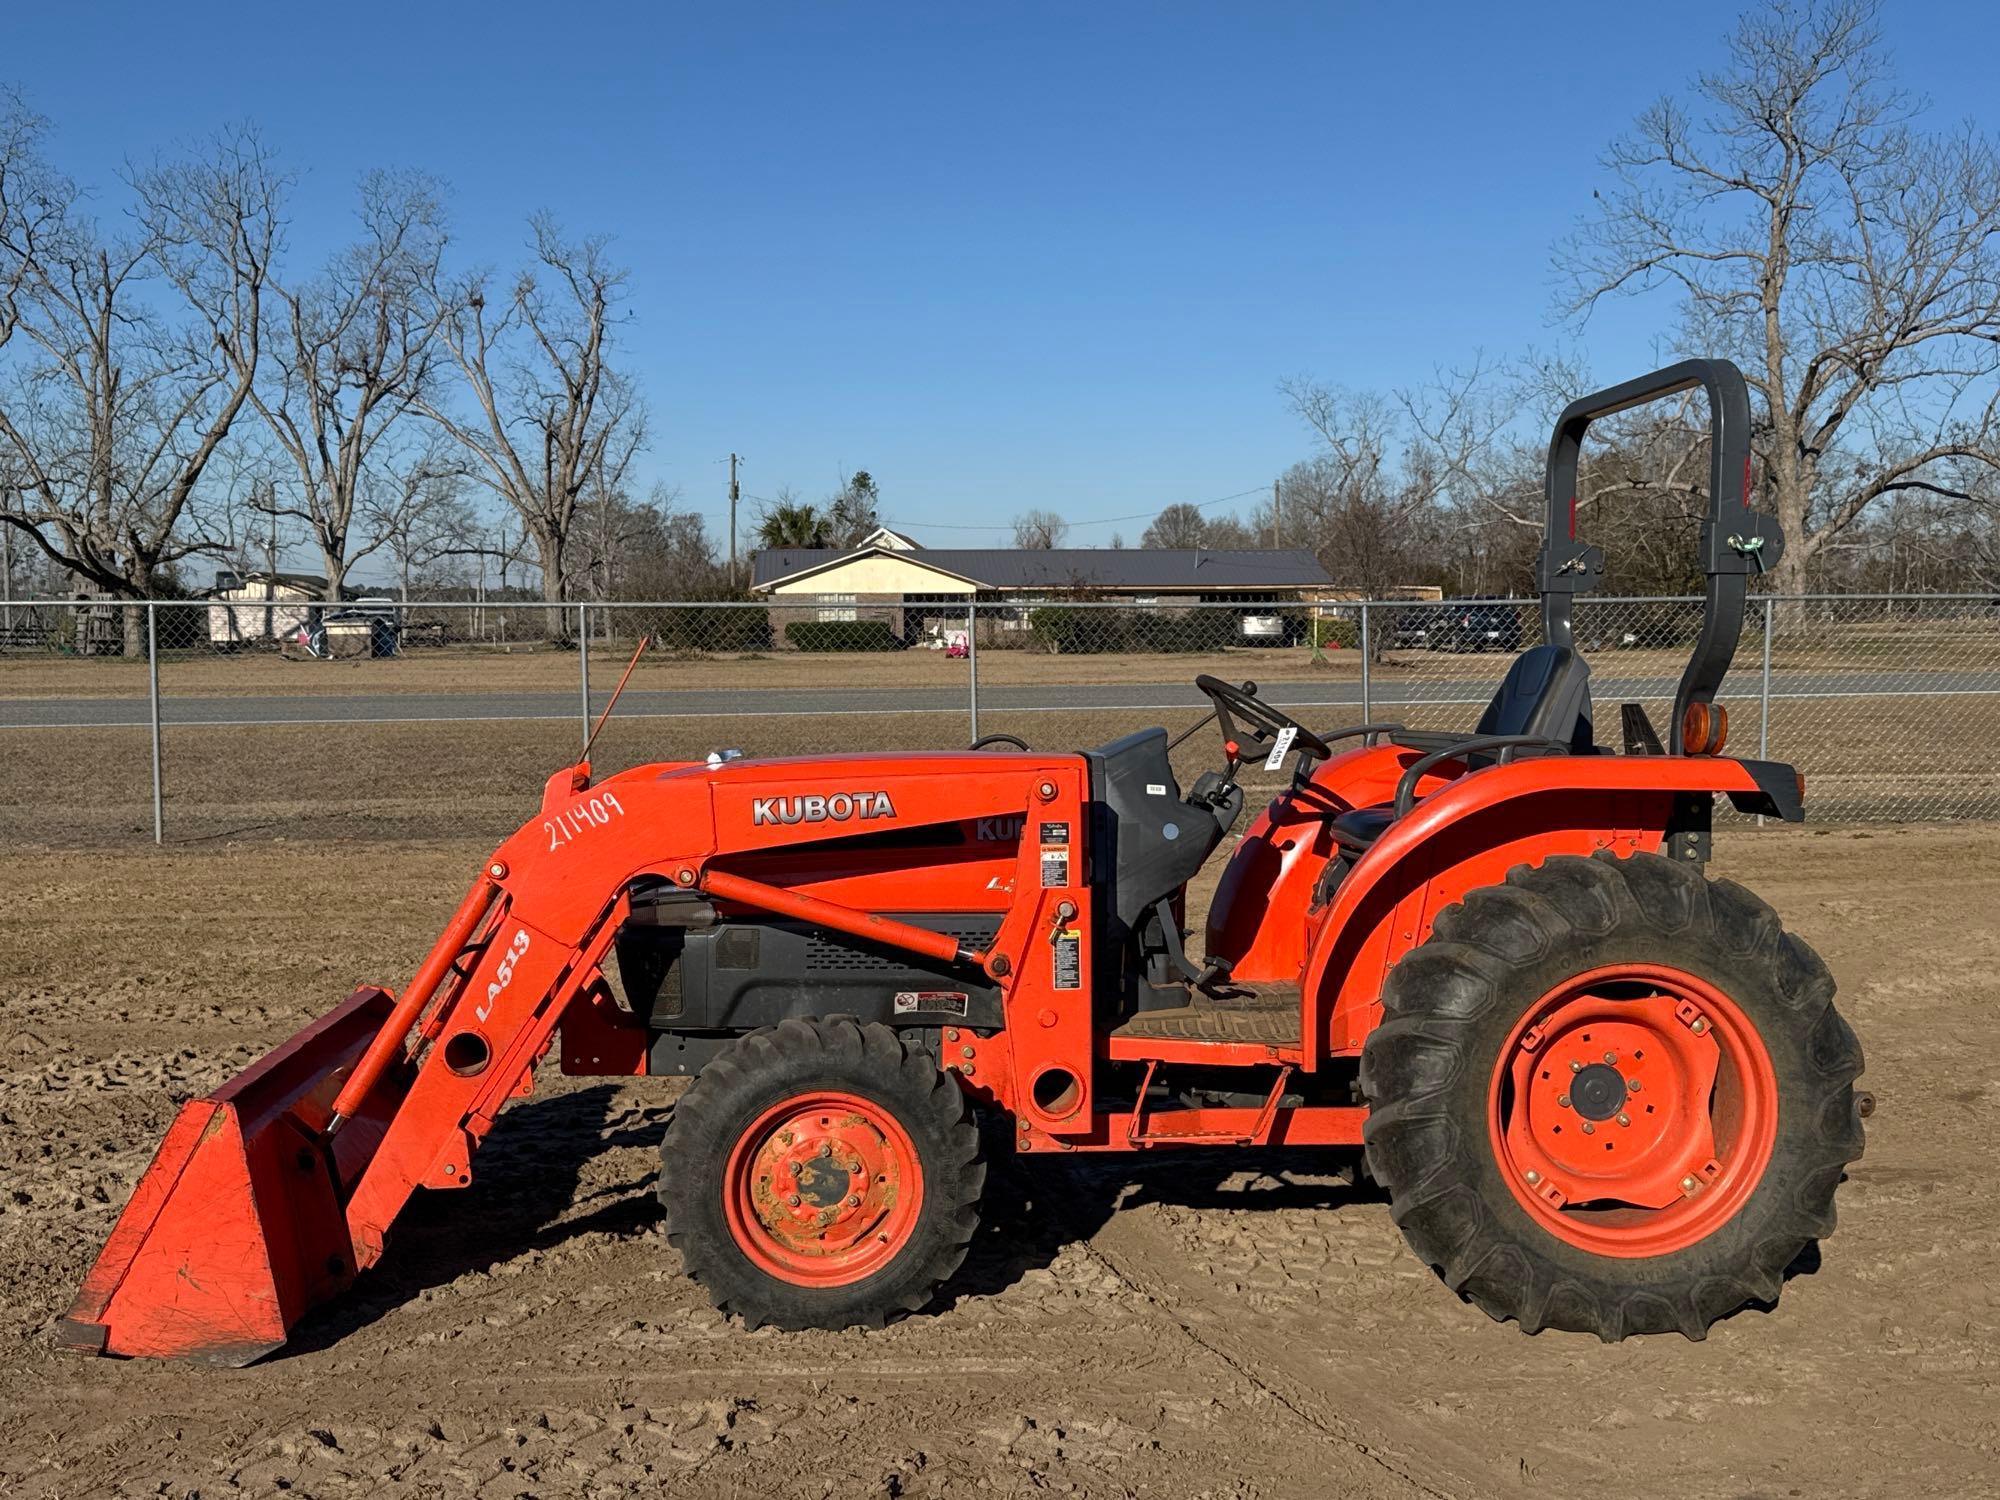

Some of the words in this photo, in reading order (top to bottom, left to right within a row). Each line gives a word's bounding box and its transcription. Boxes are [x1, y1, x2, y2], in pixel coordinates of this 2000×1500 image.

[543, 792, 625, 852] 211409
[753, 791, 897, 826] KUBOTA
[475, 929, 531, 1024] LA513
